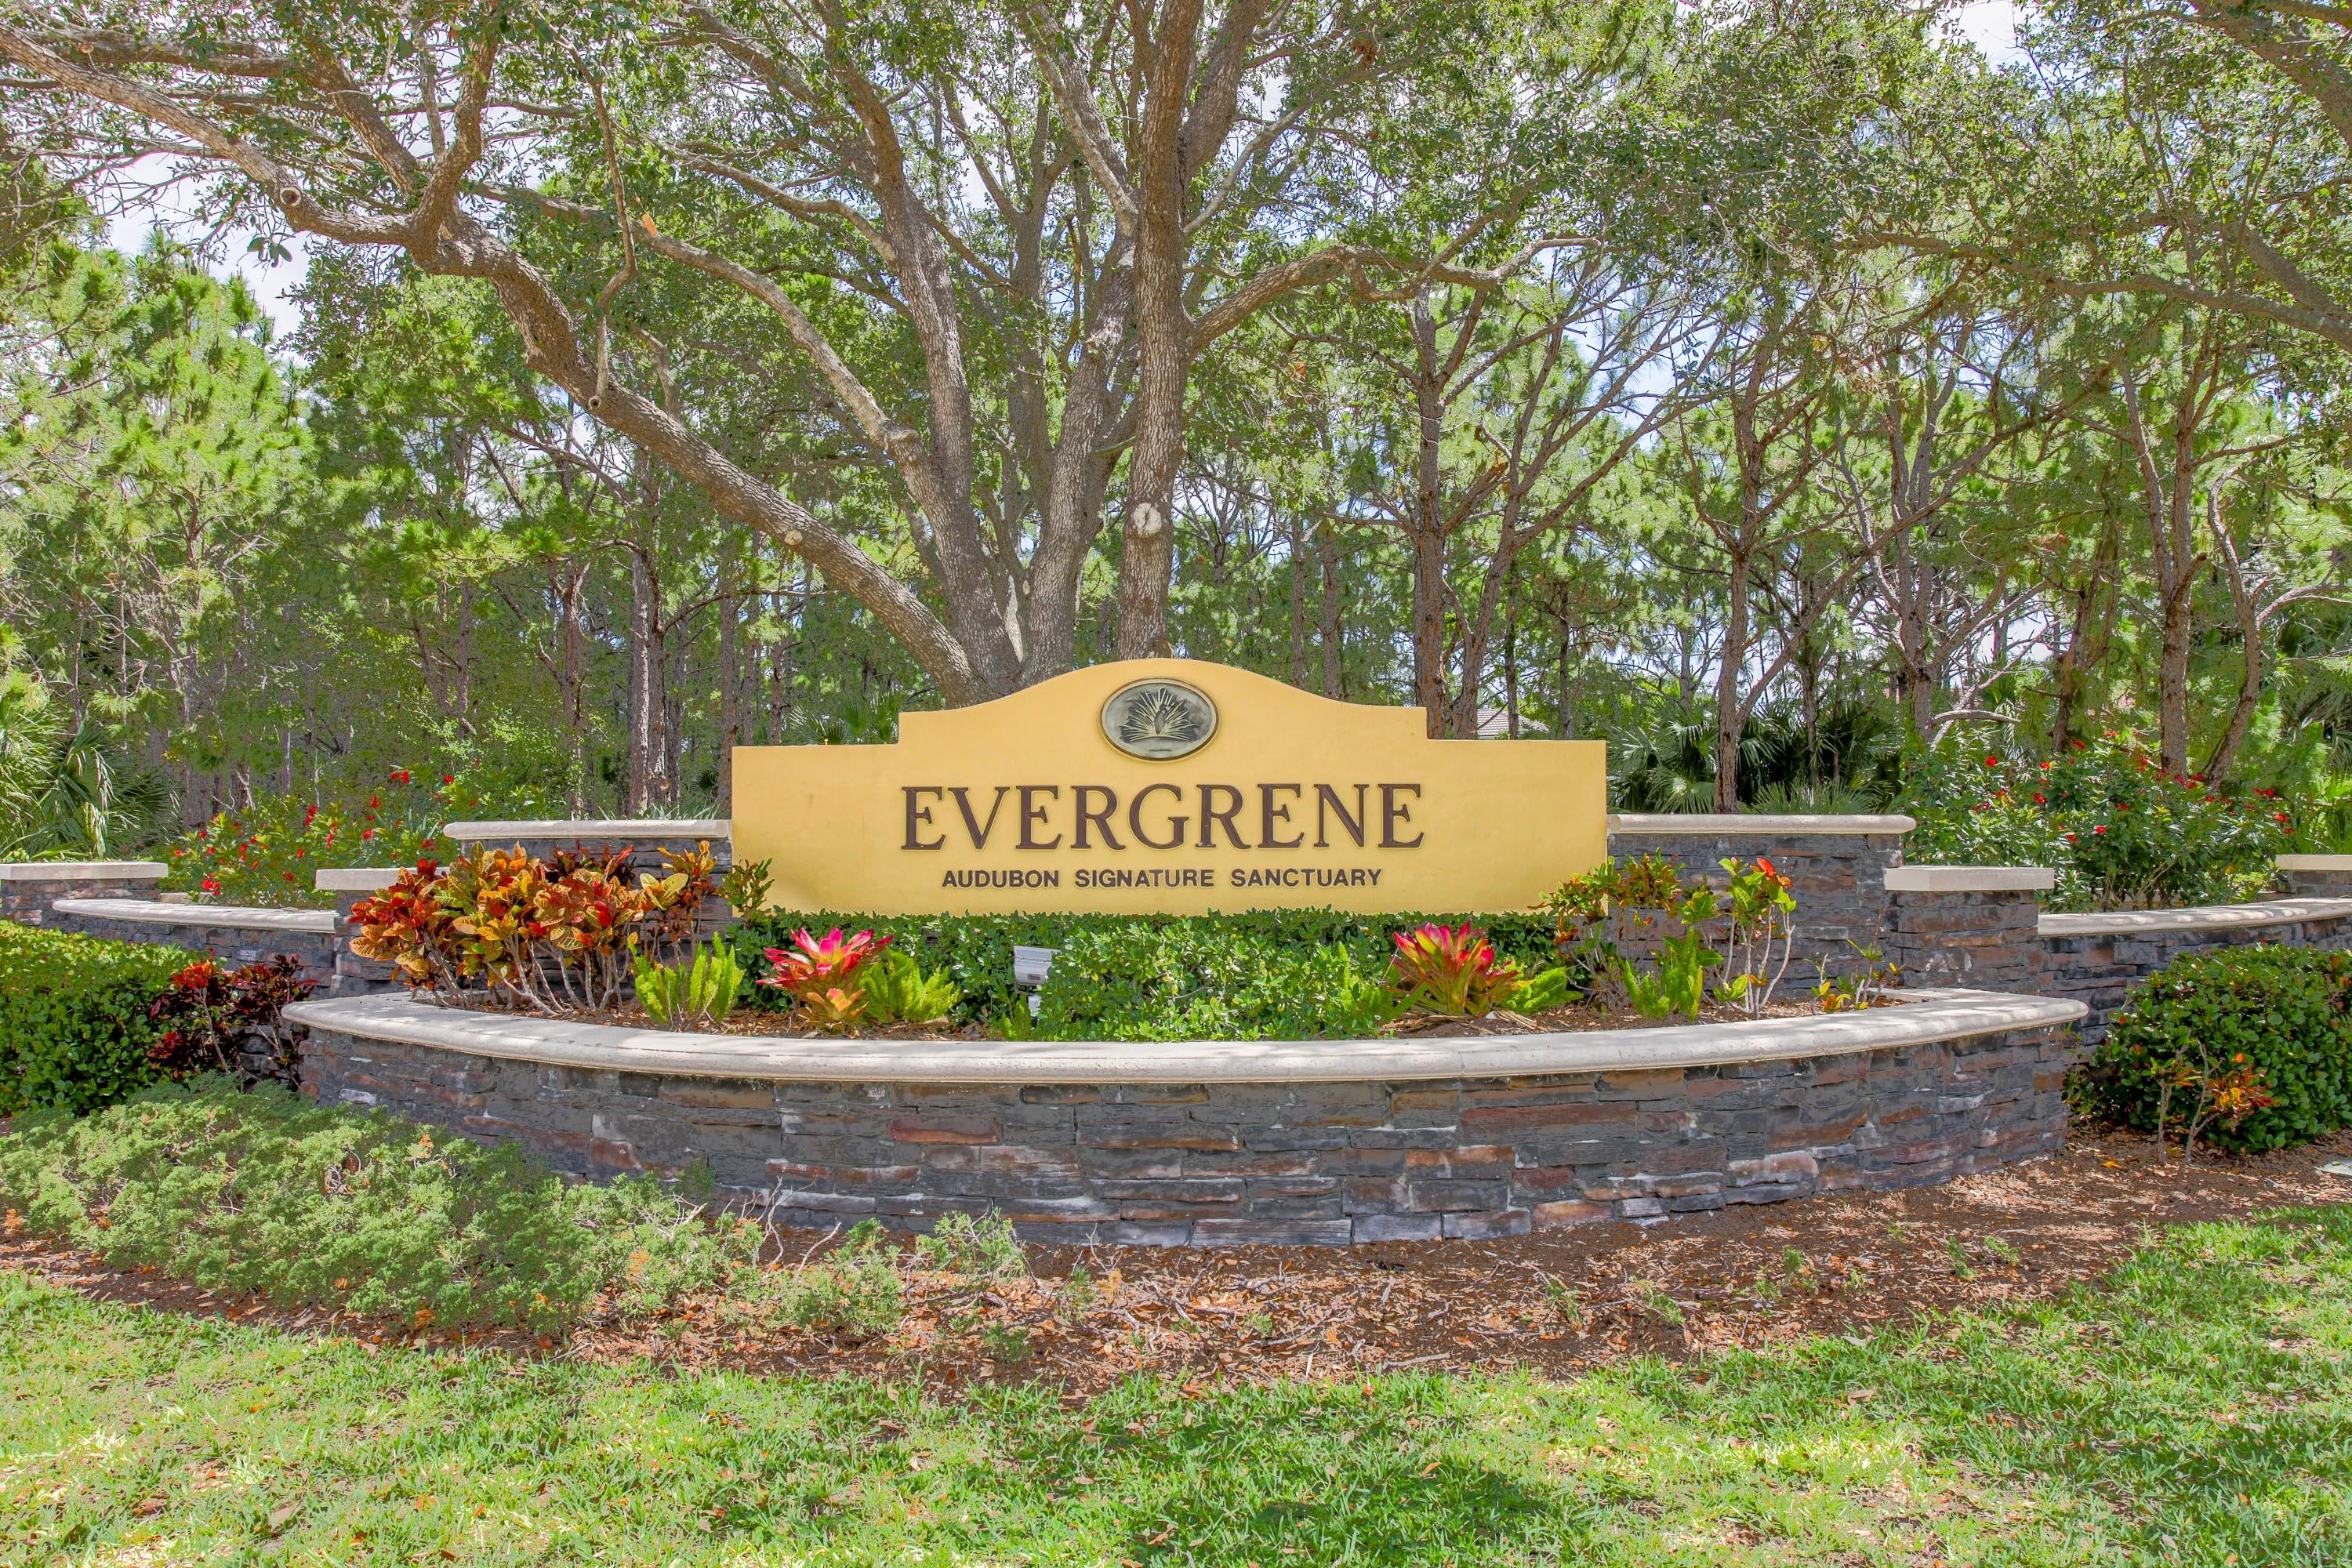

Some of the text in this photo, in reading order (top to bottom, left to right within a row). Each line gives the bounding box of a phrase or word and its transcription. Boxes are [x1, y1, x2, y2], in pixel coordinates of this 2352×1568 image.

[901, 784, 1424, 850] EVERGRENE
[942, 868, 1382, 887] AUDUBON SIGNATURE SANCTUARY
